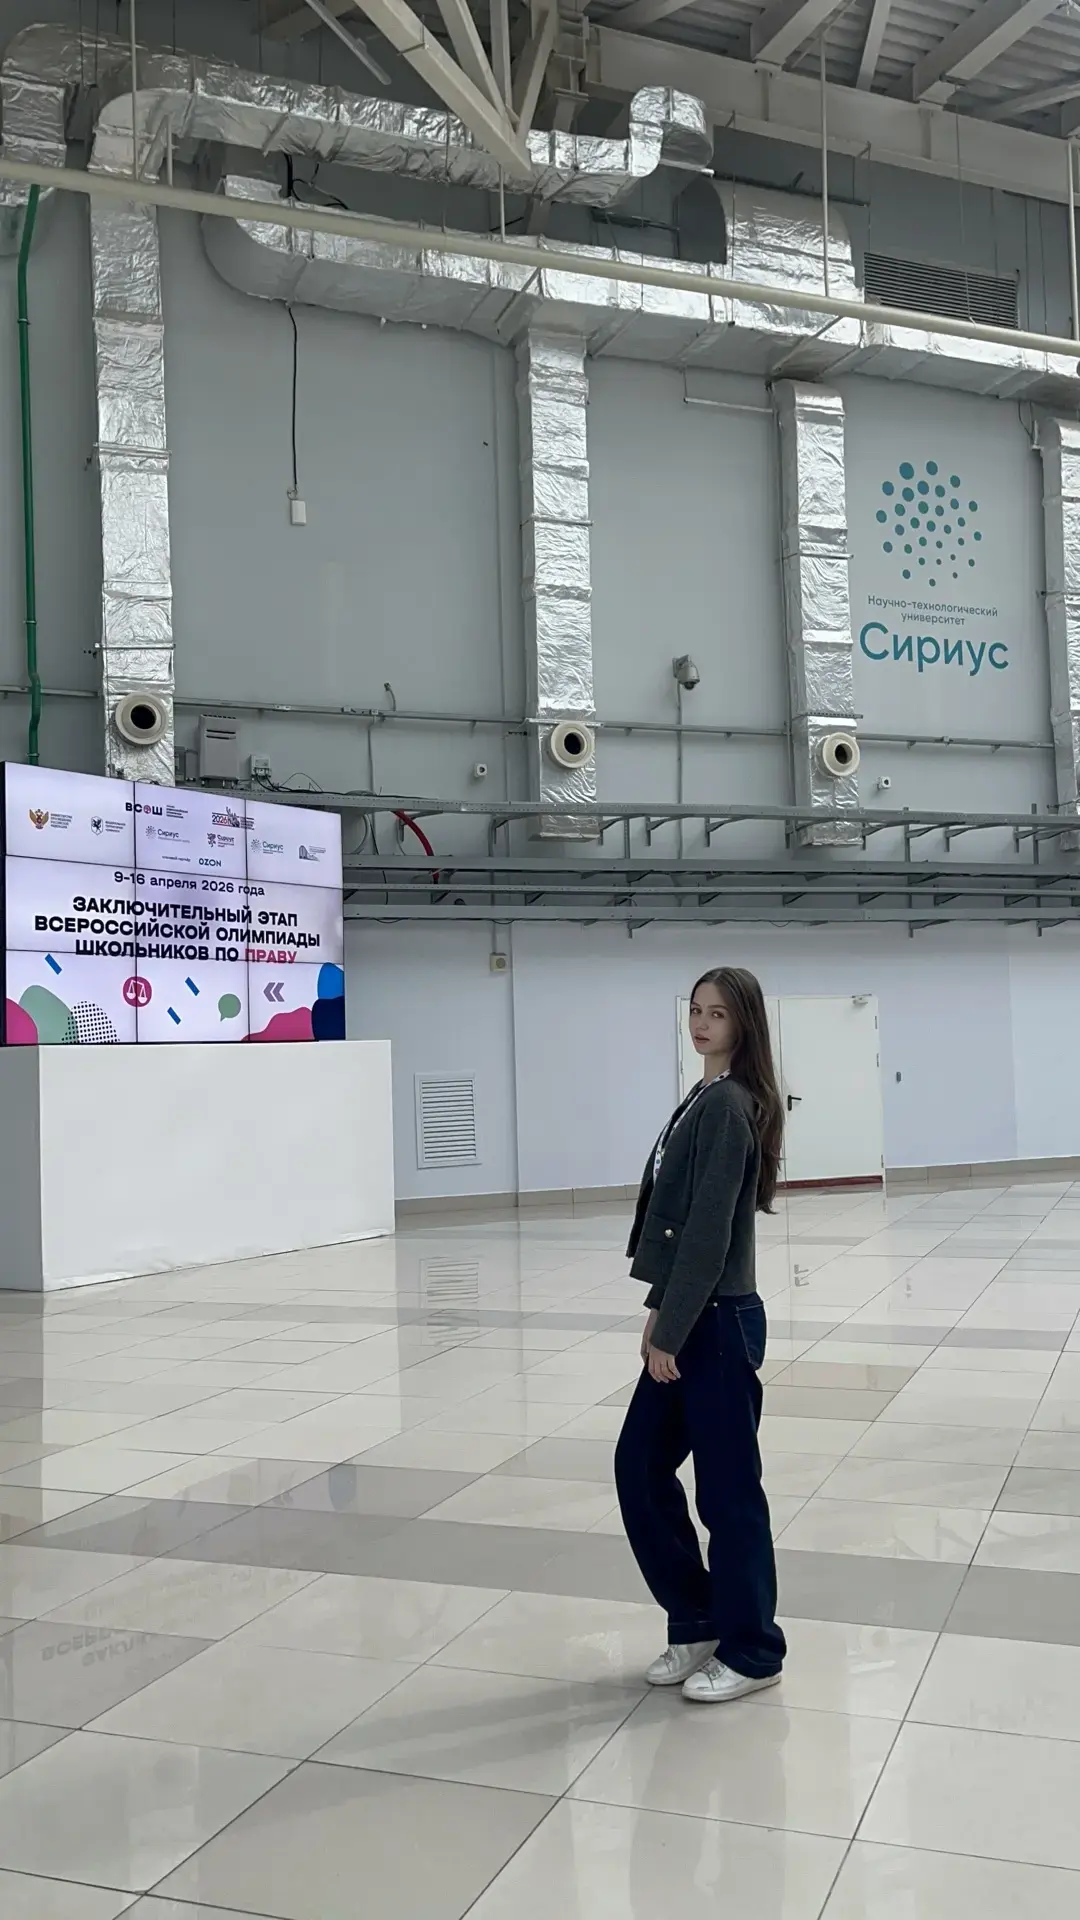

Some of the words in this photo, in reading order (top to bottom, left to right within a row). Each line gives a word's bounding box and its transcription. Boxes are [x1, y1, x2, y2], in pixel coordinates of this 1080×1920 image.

[867, 594, 998, 617] Научно-технологический
[901, 612, 966, 626] университет
[859, 621, 1009, 677] Сириус
[150, 876, 197, 891] апреля
[202, 880, 235, 893] 2026
[238, 884, 265, 897] года
[73, 896, 252, 923] ЗАКЛЮЧИТЕЛЬНЫЙ
[258, 911, 298, 927] ЭТАП
[35, 916, 210, 941] ВСЕРОССИЙСКОЙ
[216, 928, 320, 948] ОЛИМПИАДЫ
[76, 940, 209, 961] ШКОЛЬНИКОВ
[215, 947, 239, 961] ПО
[245, 948, 297, 964] ПРАВУ
